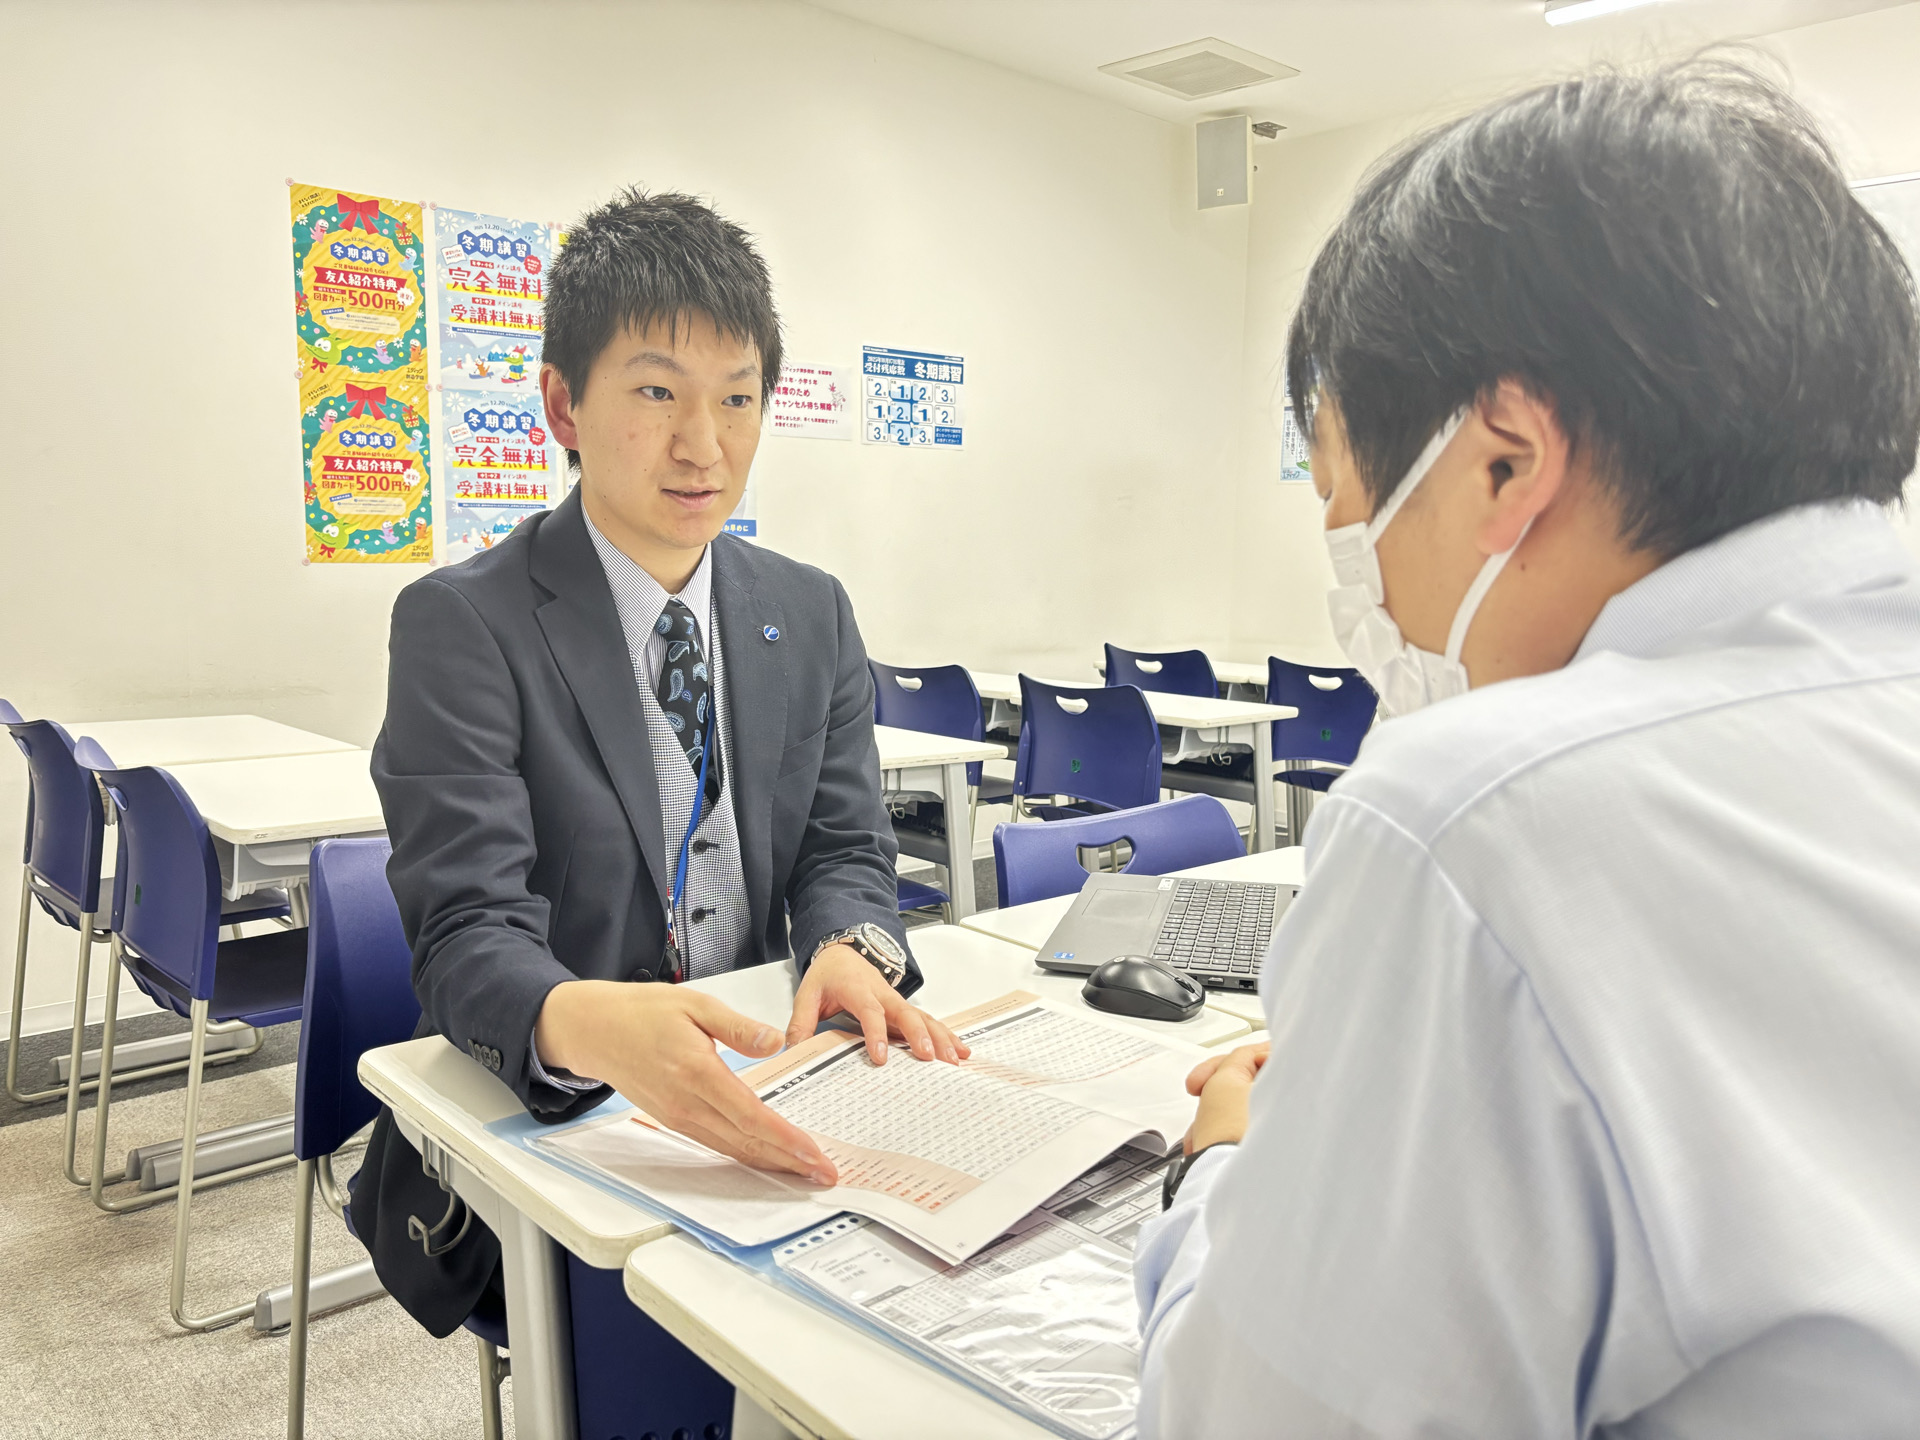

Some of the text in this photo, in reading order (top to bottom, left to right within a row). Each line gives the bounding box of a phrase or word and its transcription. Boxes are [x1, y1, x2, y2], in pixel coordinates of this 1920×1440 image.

[462, 234, 527, 258] 冬期講習
[333, 244, 386, 264] 冬期講習
[325, 270, 398, 292] 友人紹介特典
[448, 267, 543, 299] 完全無料
[451, 304, 542, 330] 受講料無料
[914, 361, 963, 383] 冬期講習
[874, 383, 882, 396] 2
[897, 385, 905, 398] 1
[919, 387, 927, 400] 2
[941, 389, 949, 402] 3
[873, 405, 882, 418] 1
[896, 406, 904, 420] 2
[918, 409, 927, 421] 1
[941, 411, 949, 423] 2
[468, 412, 532, 430] 冬期講習
[342, 433, 393, 447] 冬期講習
[873, 427, 881, 440] 3
[897, 429, 905, 441] 2
[919, 430, 927, 443] 3
[455, 444, 548, 470] 完全無料
[333, 458, 404, 473] 友人紹介特典
[457, 480, 548, 500] 受講料無料
